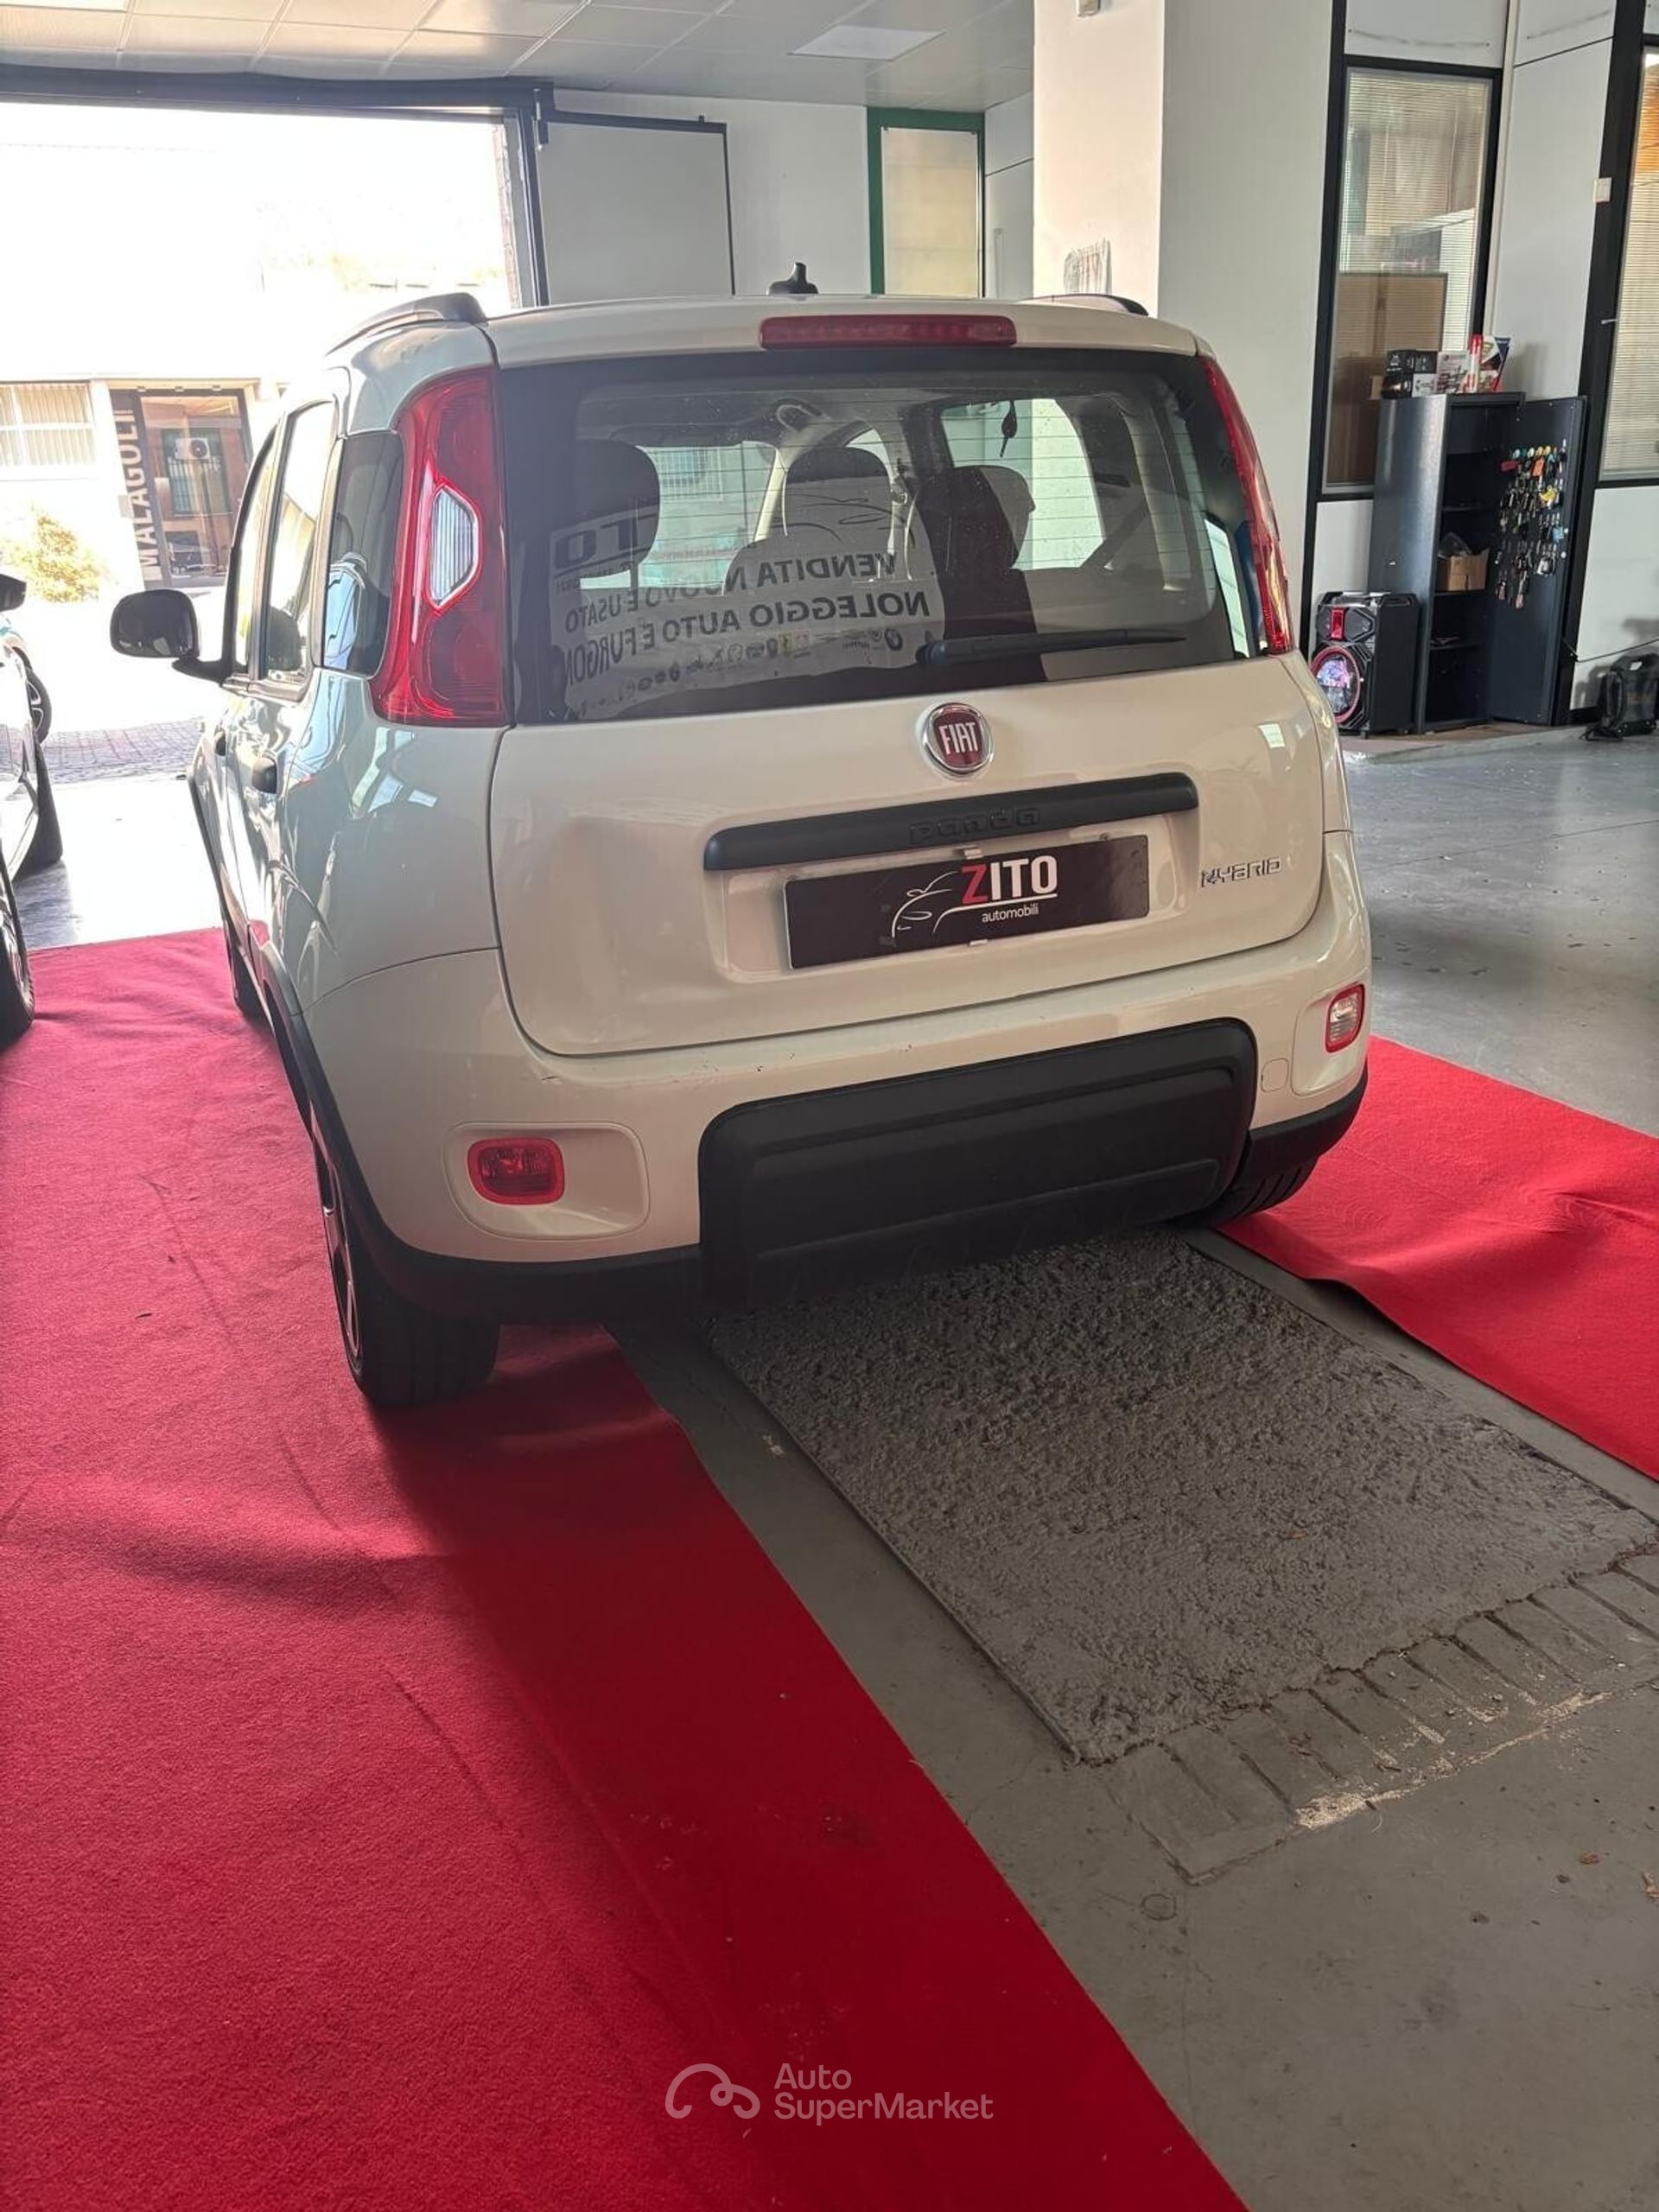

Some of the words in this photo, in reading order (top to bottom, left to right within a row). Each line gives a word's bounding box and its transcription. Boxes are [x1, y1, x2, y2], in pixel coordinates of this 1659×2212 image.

[938, 721, 979, 755] FIAT
[961, 855, 1058, 906] ZITO
[1200, 858, 1281, 888] HYBRID
[981, 903, 1040, 924] automobili
